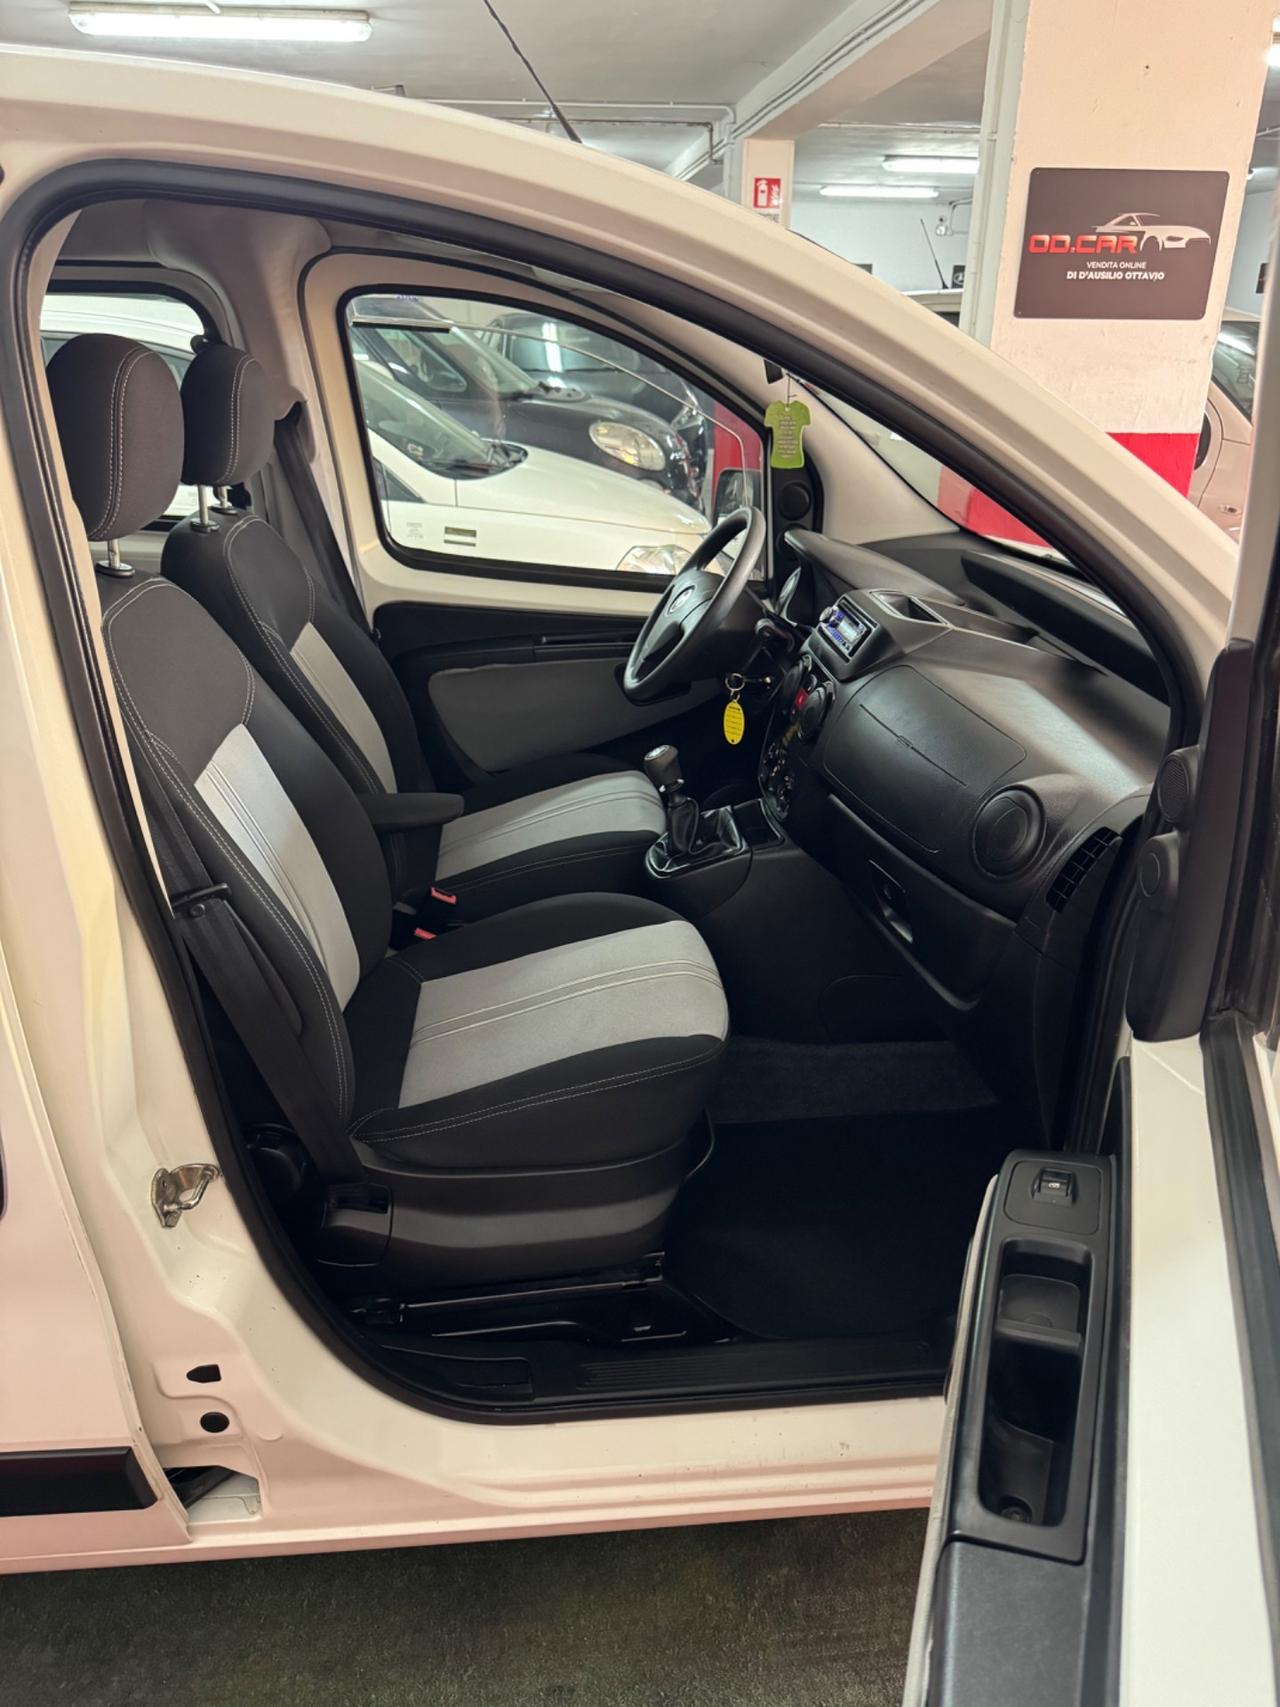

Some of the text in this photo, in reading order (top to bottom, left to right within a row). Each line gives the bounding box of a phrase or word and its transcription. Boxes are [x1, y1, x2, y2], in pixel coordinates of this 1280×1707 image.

[1028, 235, 1138, 254] OD.CAR
[1066, 271, 1165, 280] DI D'AUSILIO OTTAVIO
